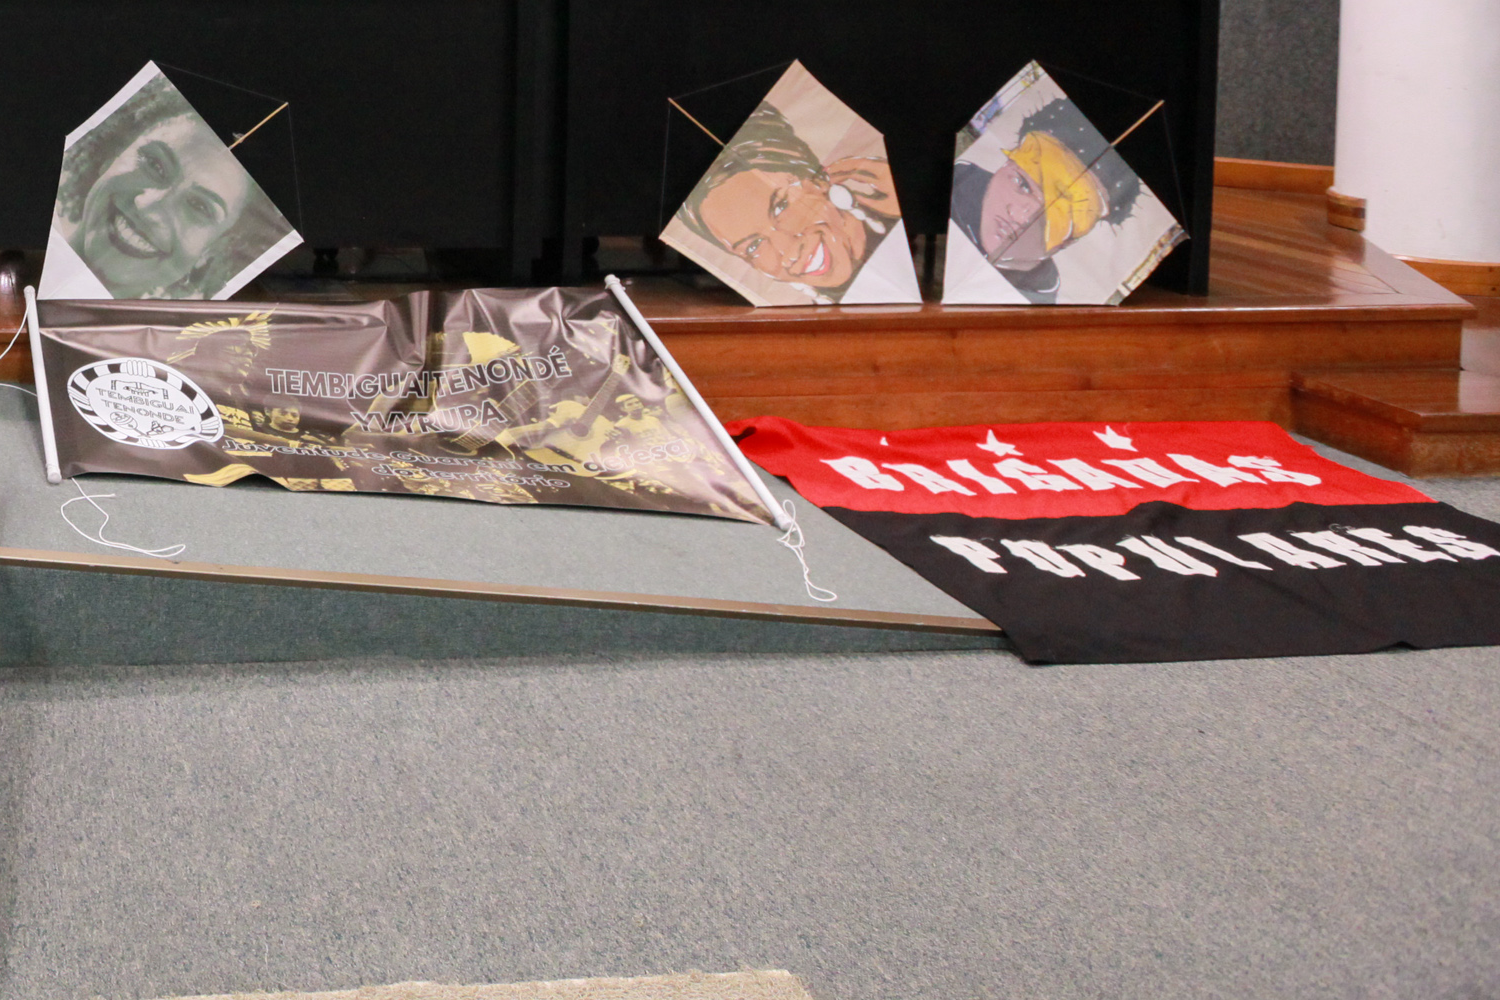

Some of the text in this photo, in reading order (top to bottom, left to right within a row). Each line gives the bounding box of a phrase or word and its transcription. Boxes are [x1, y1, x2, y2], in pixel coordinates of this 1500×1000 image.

[265, 346, 573, 399] TEMBIGUAI TENONDÉ
[95, 387, 195, 415] TEMBIGUAI
[349, 400, 507, 435] YVYRUPA
[221, 438, 690, 474] Juventude Guarani em defesa
[371, 463, 419, 478] do
[929, 524, 1500, 581] POPULARES
